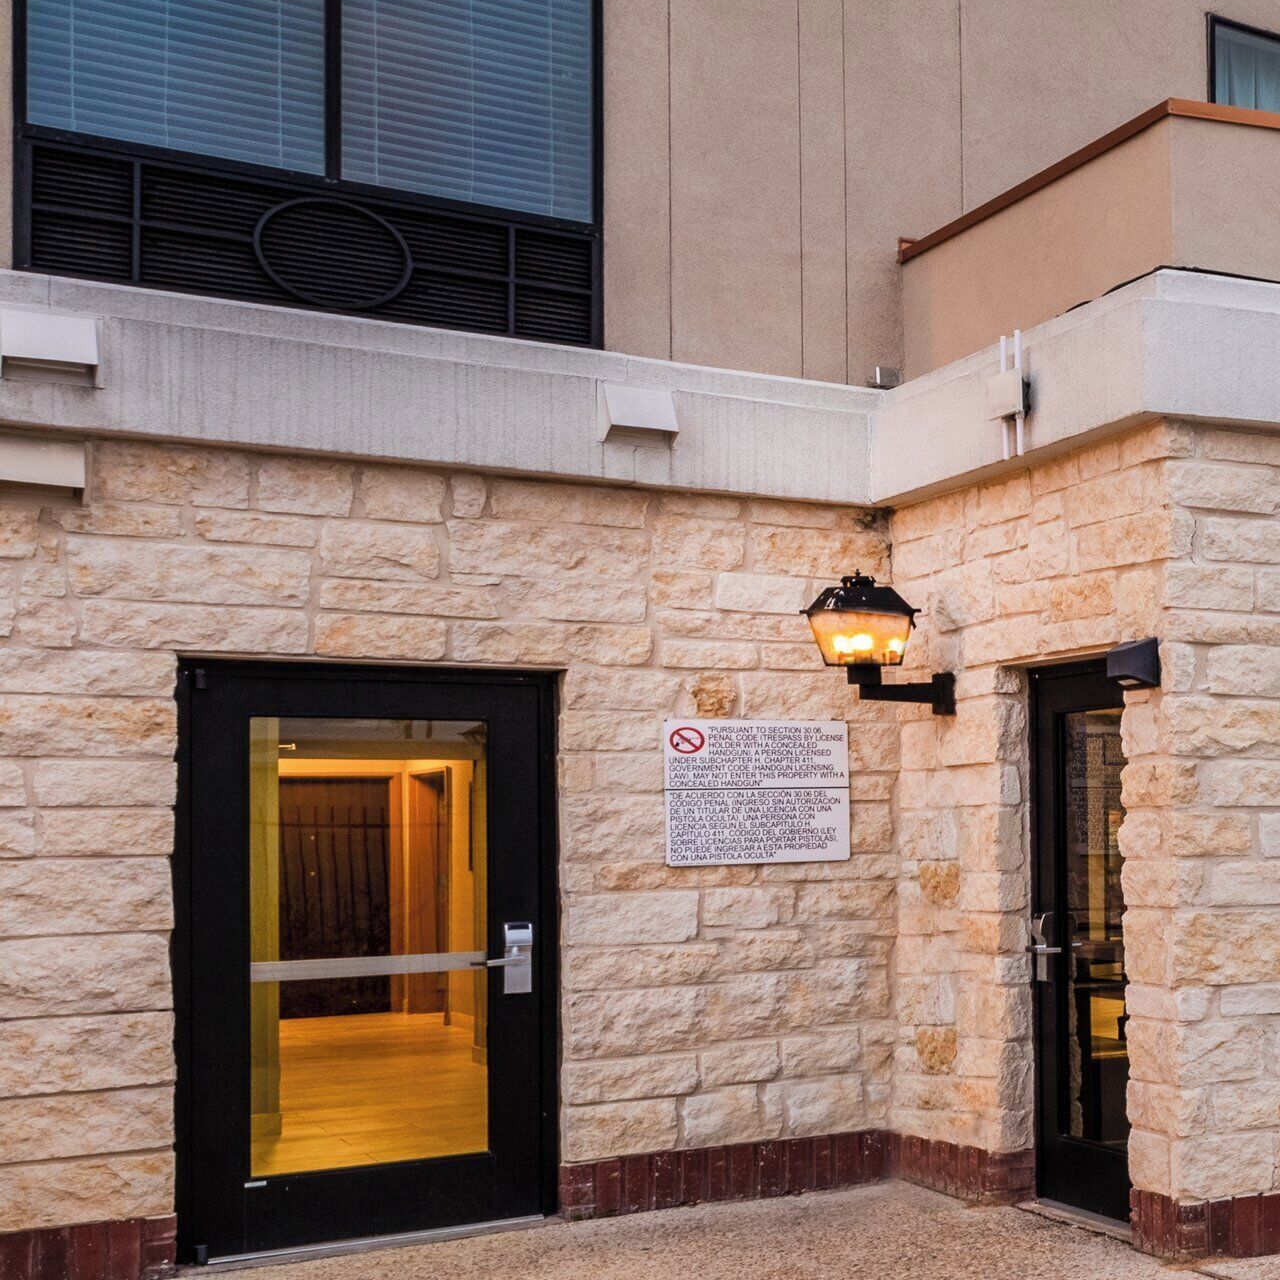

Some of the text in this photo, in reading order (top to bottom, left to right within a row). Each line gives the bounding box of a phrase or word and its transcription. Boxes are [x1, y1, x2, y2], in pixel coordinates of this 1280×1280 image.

[708, 741, 741, 749] HOLDER
[764, 756, 800, 764] CHAPTER
[669, 764, 726, 772] GOVERNMENT
[727, 764, 750, 772] CODE
[777, 771, 818, 779] PROPERTY
[669, 780, 719, 788] CONCEALED
[685, 791, 725, 799] ACUERDO
[726, 791, 745, 799] CON
[793, 790, 812, 798] 30.06
[813, 790, 828, 798] DEL
[704, 799, 730, 807] PENAL
[771, 798, 785, 806] SIN
[697, 807, 730, 815] TITULAR
[744, 806, 761, 814] UNA
[798, 805, 815, 813] CON
[670, 815, 704, 823] PISTOLA
[760, 813, 798, 821] PERSONA
[779, 828, 819, 836] GOBIERNO
[670, 838, 699, 847] SOBRE
[700, 837, 742, 846] LICENCIAS
[766, 835, 797, 843] PORTAR
[763, 843, 783, 851] ESTA
[784, 842, 828, 850] PROPIEDAD
[670, 854, 689, 862] CON
[690, 853, 708, 861] UNA
[709, 852, 742, 860] PISTOLA
